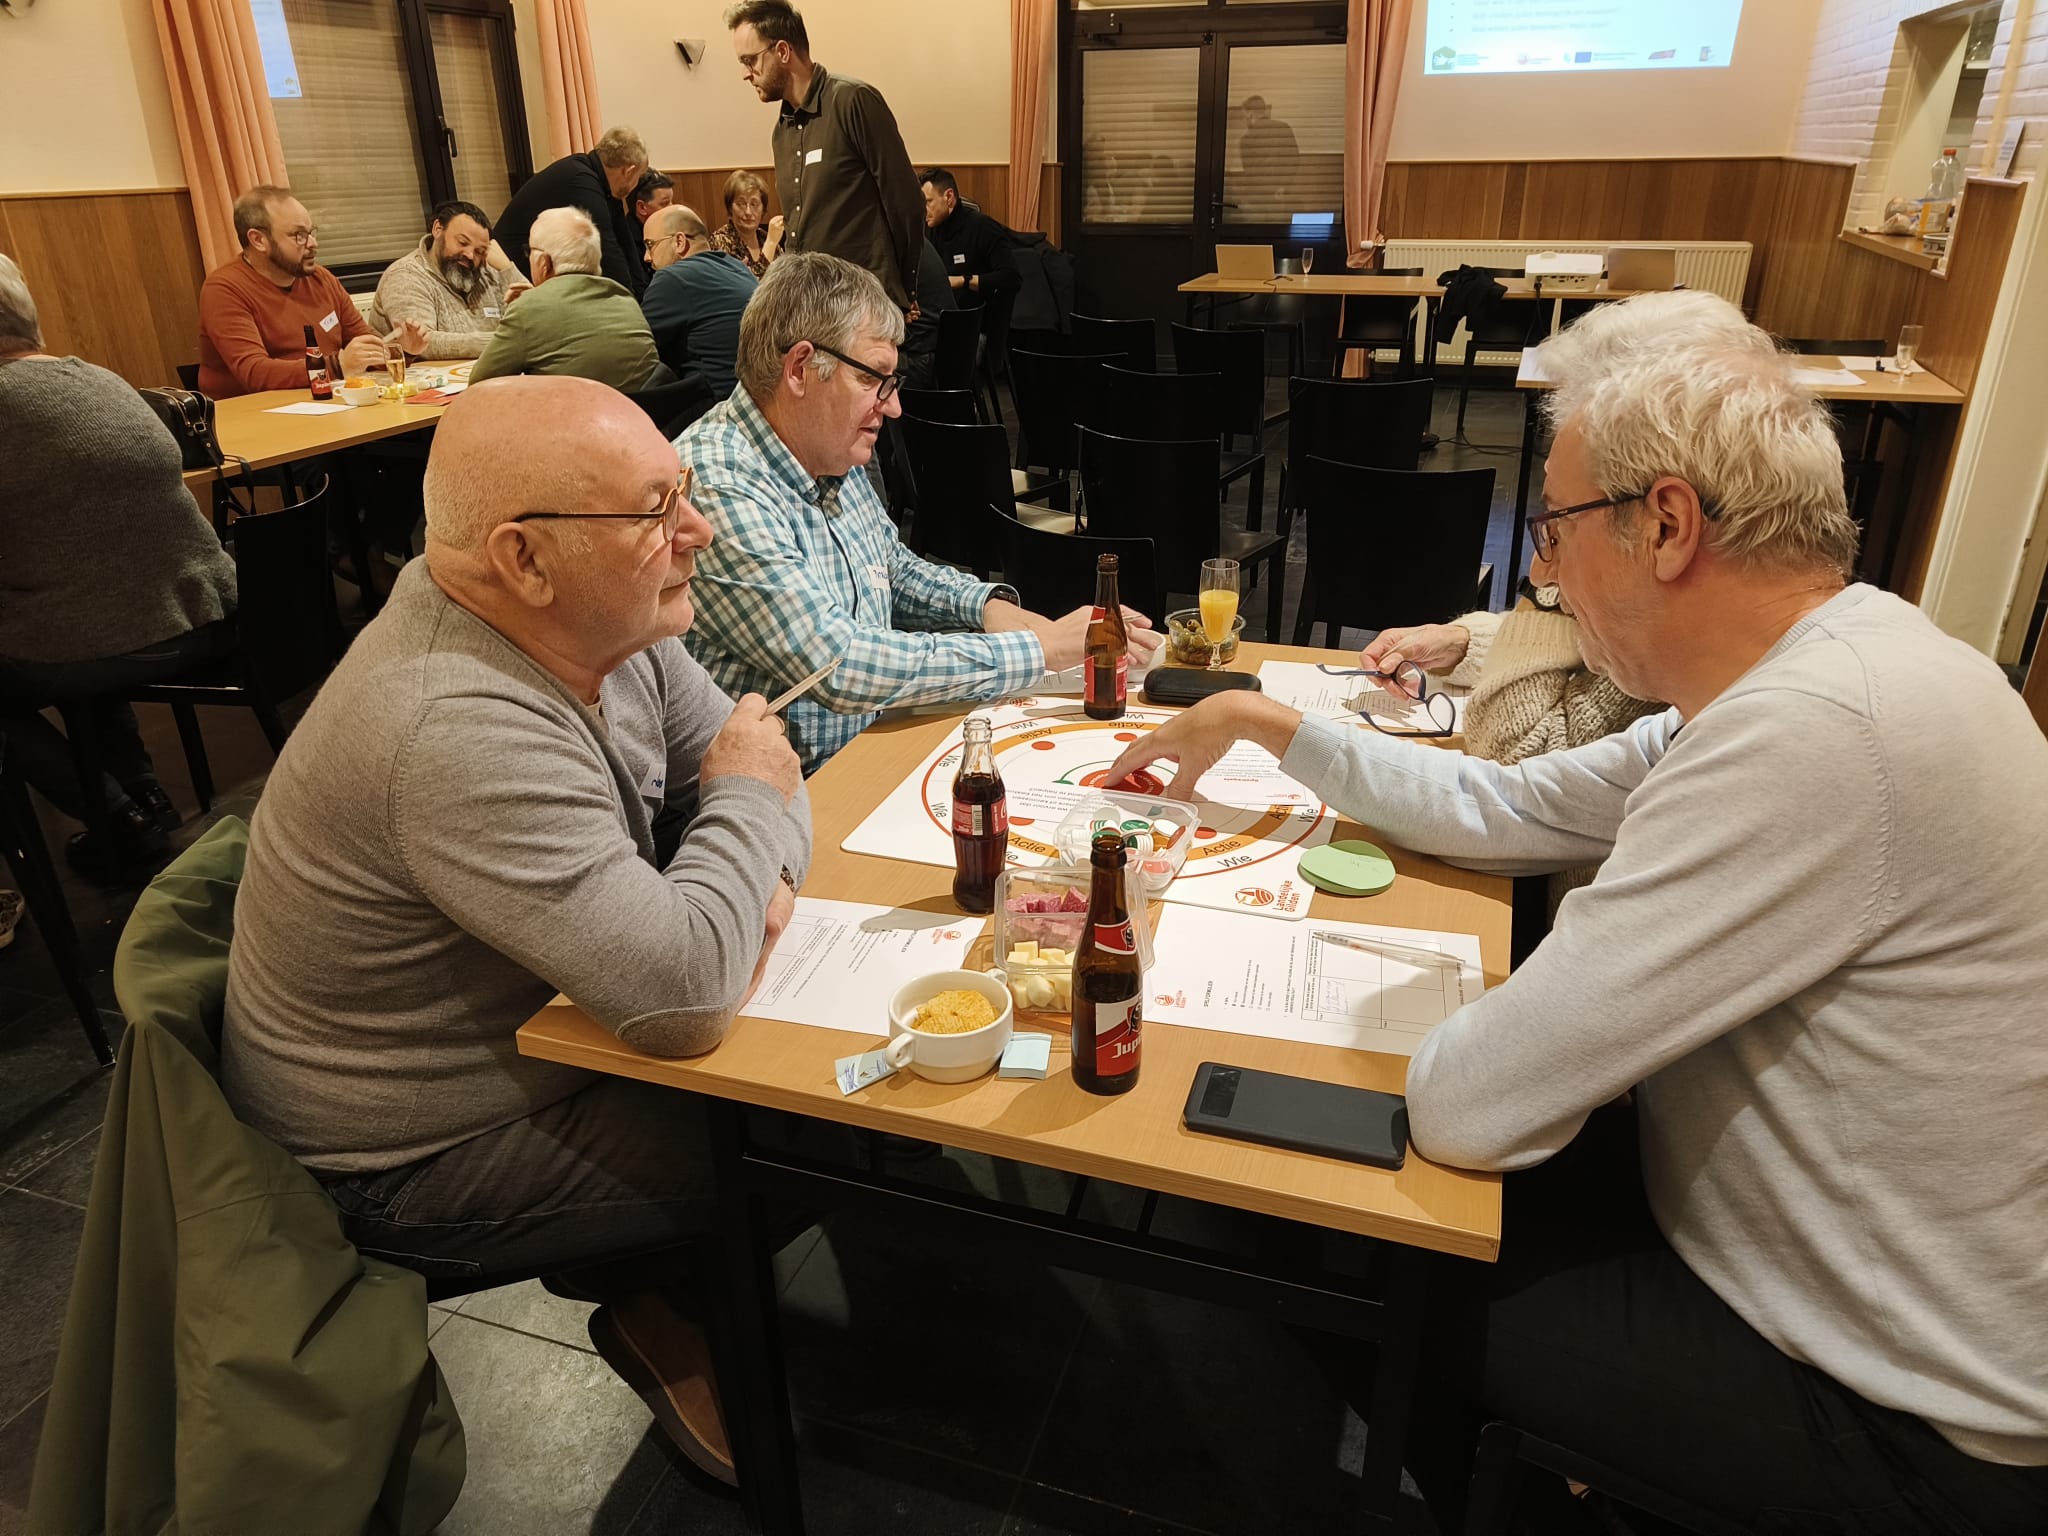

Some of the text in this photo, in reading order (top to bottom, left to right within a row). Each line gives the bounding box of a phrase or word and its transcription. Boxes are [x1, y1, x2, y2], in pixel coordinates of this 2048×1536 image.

[1010, 721, 1038, 730] Wie
[1020, 728, 1052, 739] Actie
[938, 755, 961, 767] Wie
[931, 802, 948, 818] Wie
[1297, 809, 1319, 822] Wie
[1008, 837, 1046, 853] Actie
[1202, 840, 1241, 856] Actie
[1004, 851, 1018, 860] ie
[1217, 855, 1253, 868] Wie
